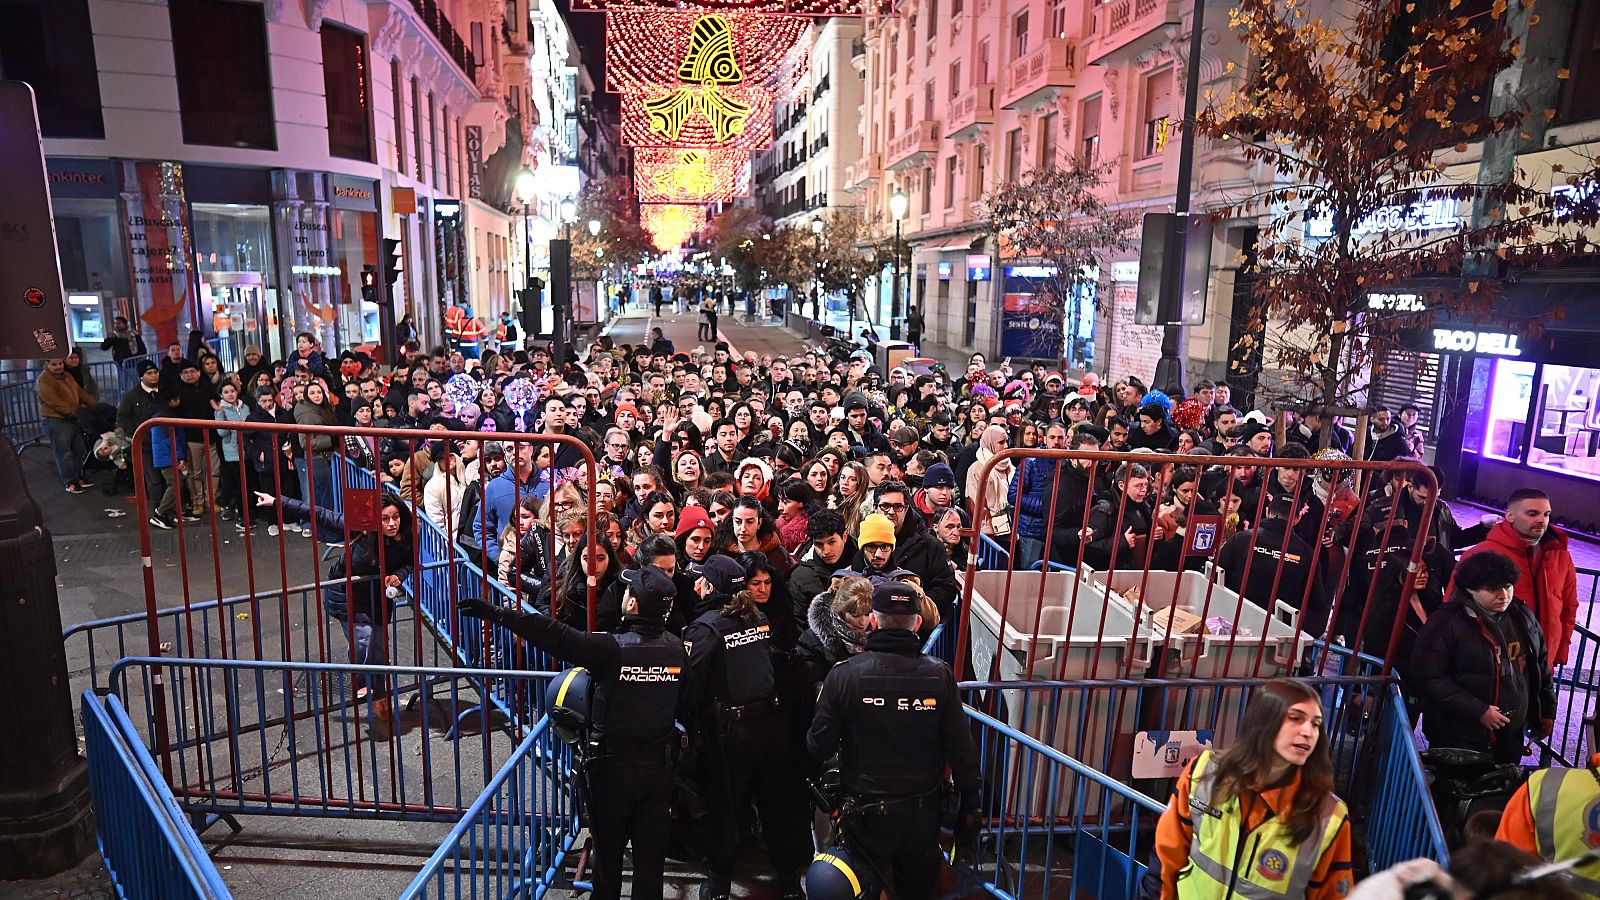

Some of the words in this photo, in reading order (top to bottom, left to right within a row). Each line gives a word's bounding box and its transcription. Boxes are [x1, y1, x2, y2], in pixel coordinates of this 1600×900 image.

[468, 127, 480, 197] NOVIAS
[47, 171, 103, 183] nkinter
[335, 186, 370, 199] bankinter
[1352, 207, 1402, 234] ACO
[297, 248, 328, 258] cajero?
[1433, 329, 1476, 352] TACO
[1476, 332, 1521, 356] BELL
[724, 627, 763, 642] POLICIA
[725, 632, 770, 649] NACIONAL
[620, 666, 670, 674] POLICIA
[619, 674, 679, 682] NACIONAL
